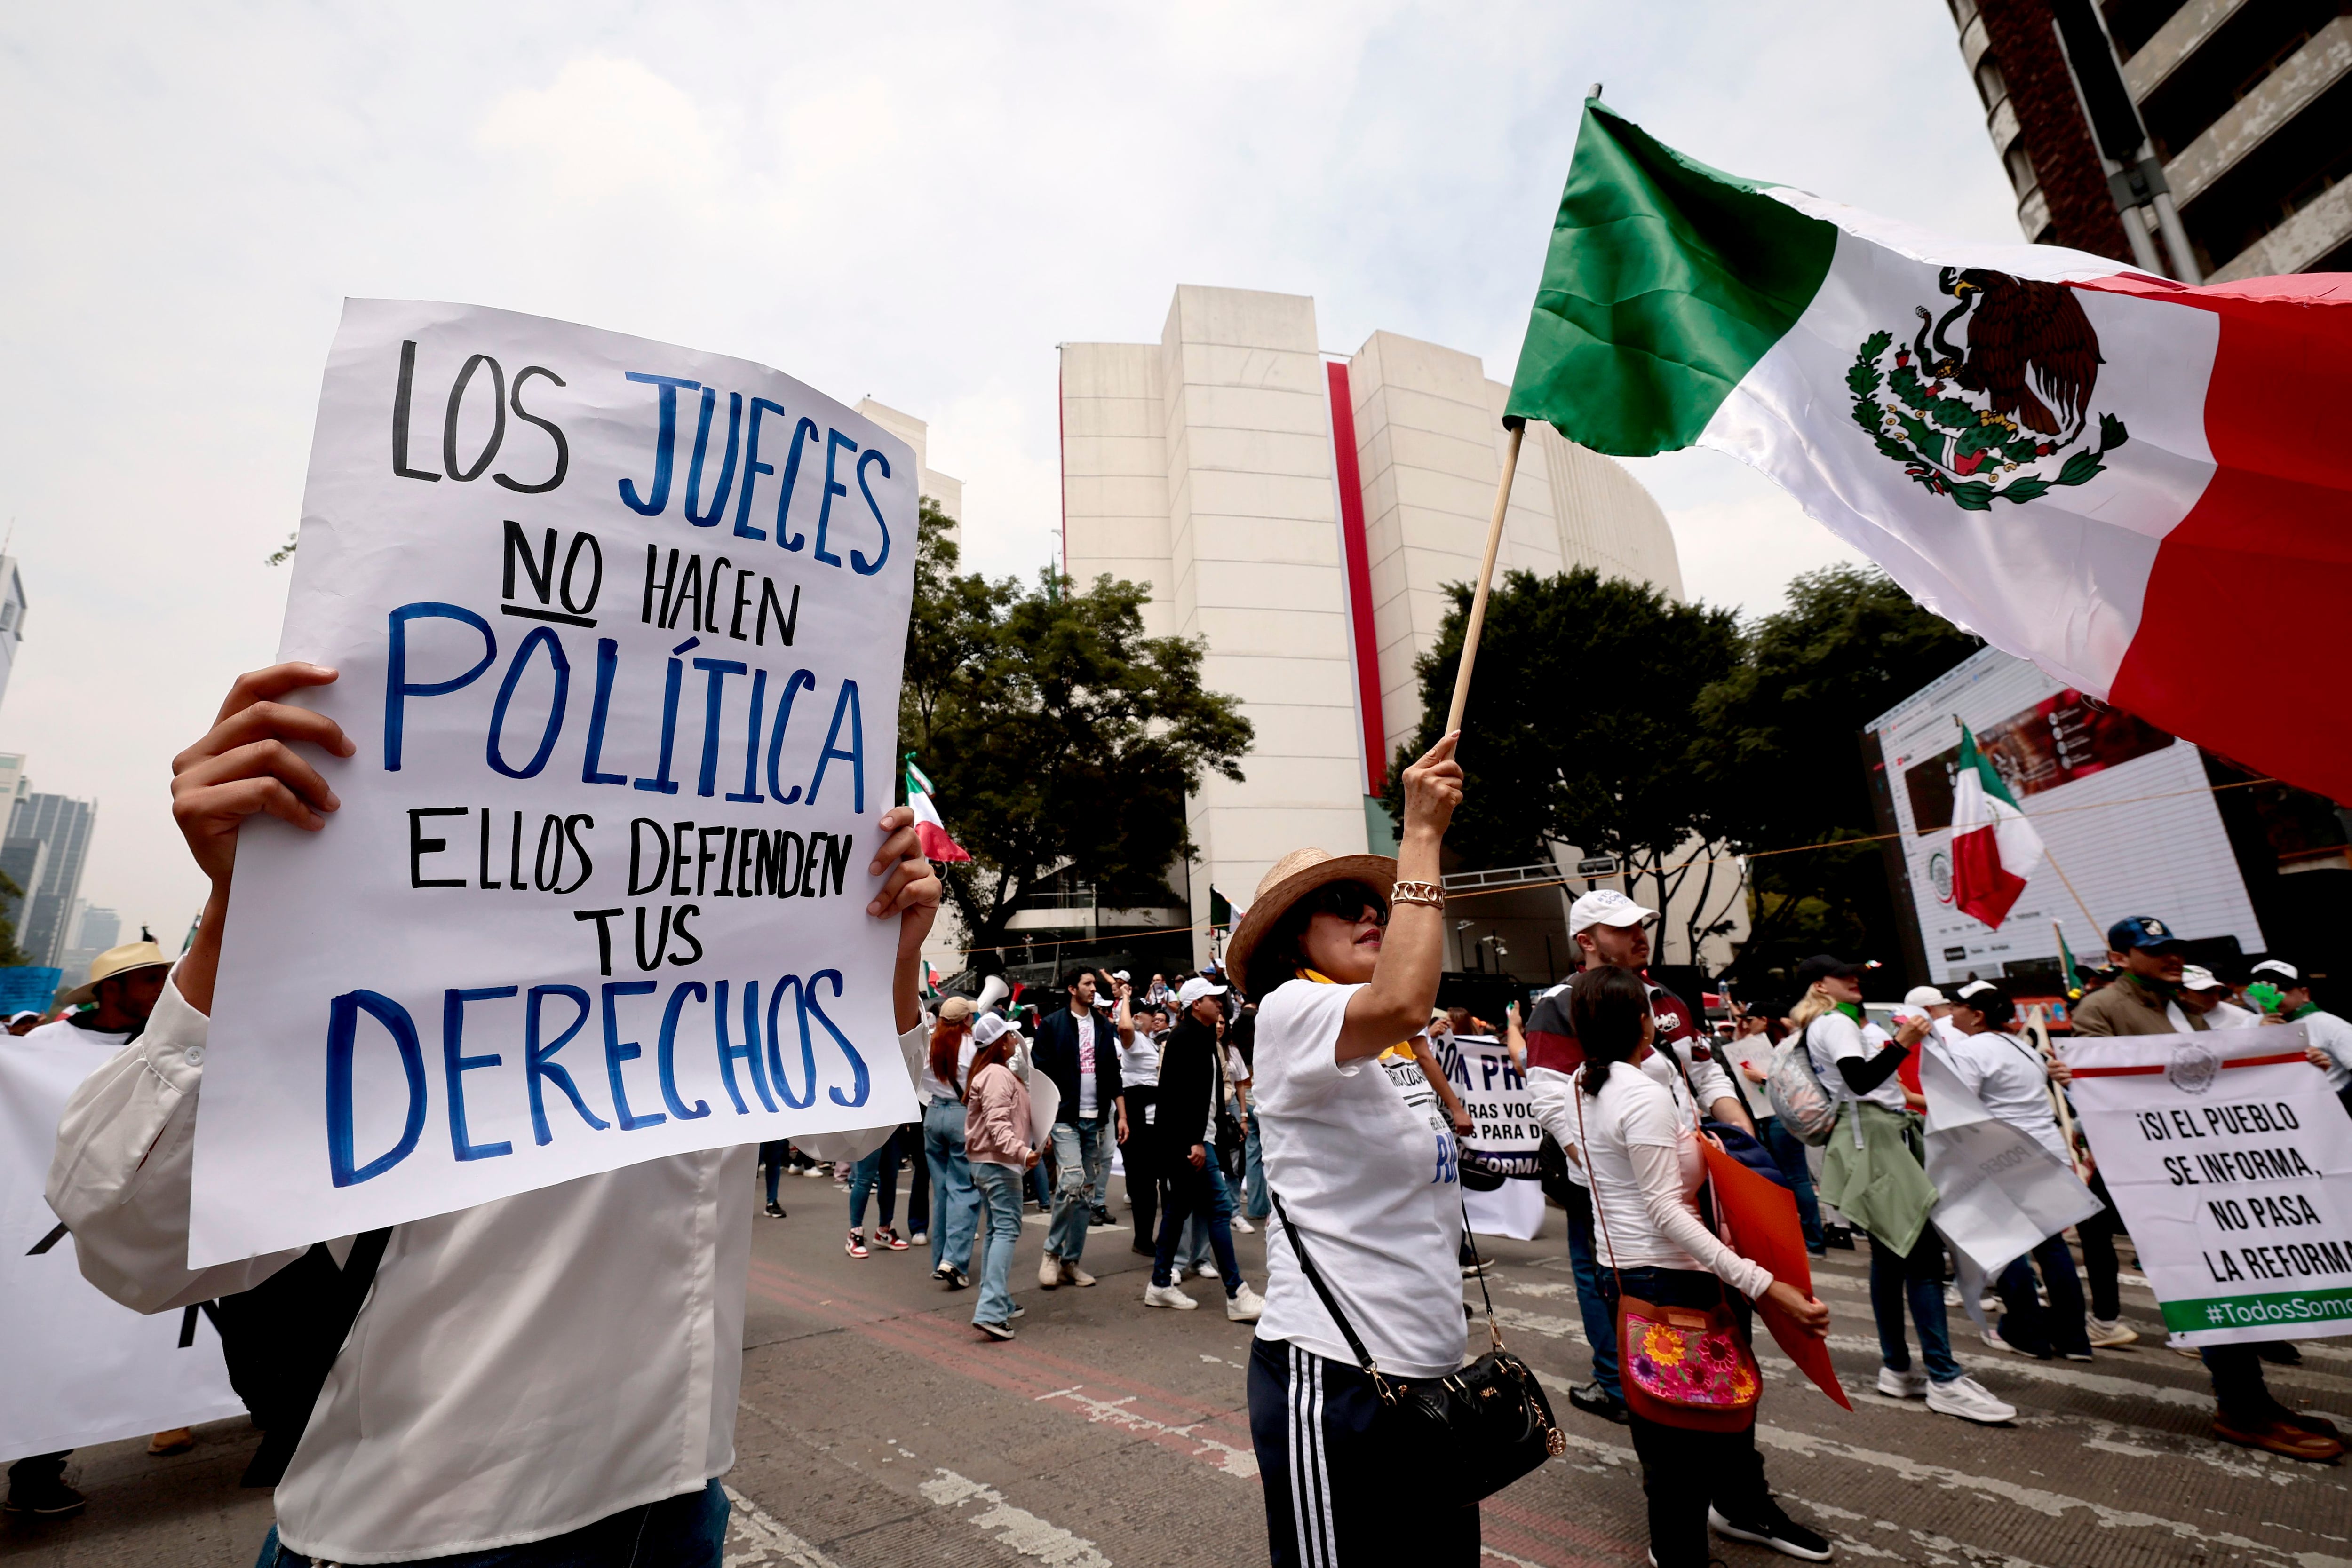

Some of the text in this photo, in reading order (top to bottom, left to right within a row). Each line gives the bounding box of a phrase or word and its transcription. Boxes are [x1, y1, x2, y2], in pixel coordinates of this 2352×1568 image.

[392, 339, 892, 576] LOS JUECES
[502, 520, 801, 647] NO HACEN
[384, 601, 865, 815] POLÍTICA
[407, 806, 853, 898] ELLOS DEFIENDEN
[574, 904, 704, 976] TUS
[326, 968, 871, 1188] DERECHOS
[1481, 1054, 1527, 1090] PR
[1482, 1124, 1524, 1139] PARA
[1529, 1124, 1544, 1139] D
[2170, 1109, 2206, 1139] EL
[2203, 1102, 2300, 1136] PUEBLO
[2164, 1147, 2323, 1186] SE INFORMA,
[2207, 1194, 2322, 1231] NO PASA
[2203, 1250, 2245, 1283] LA
